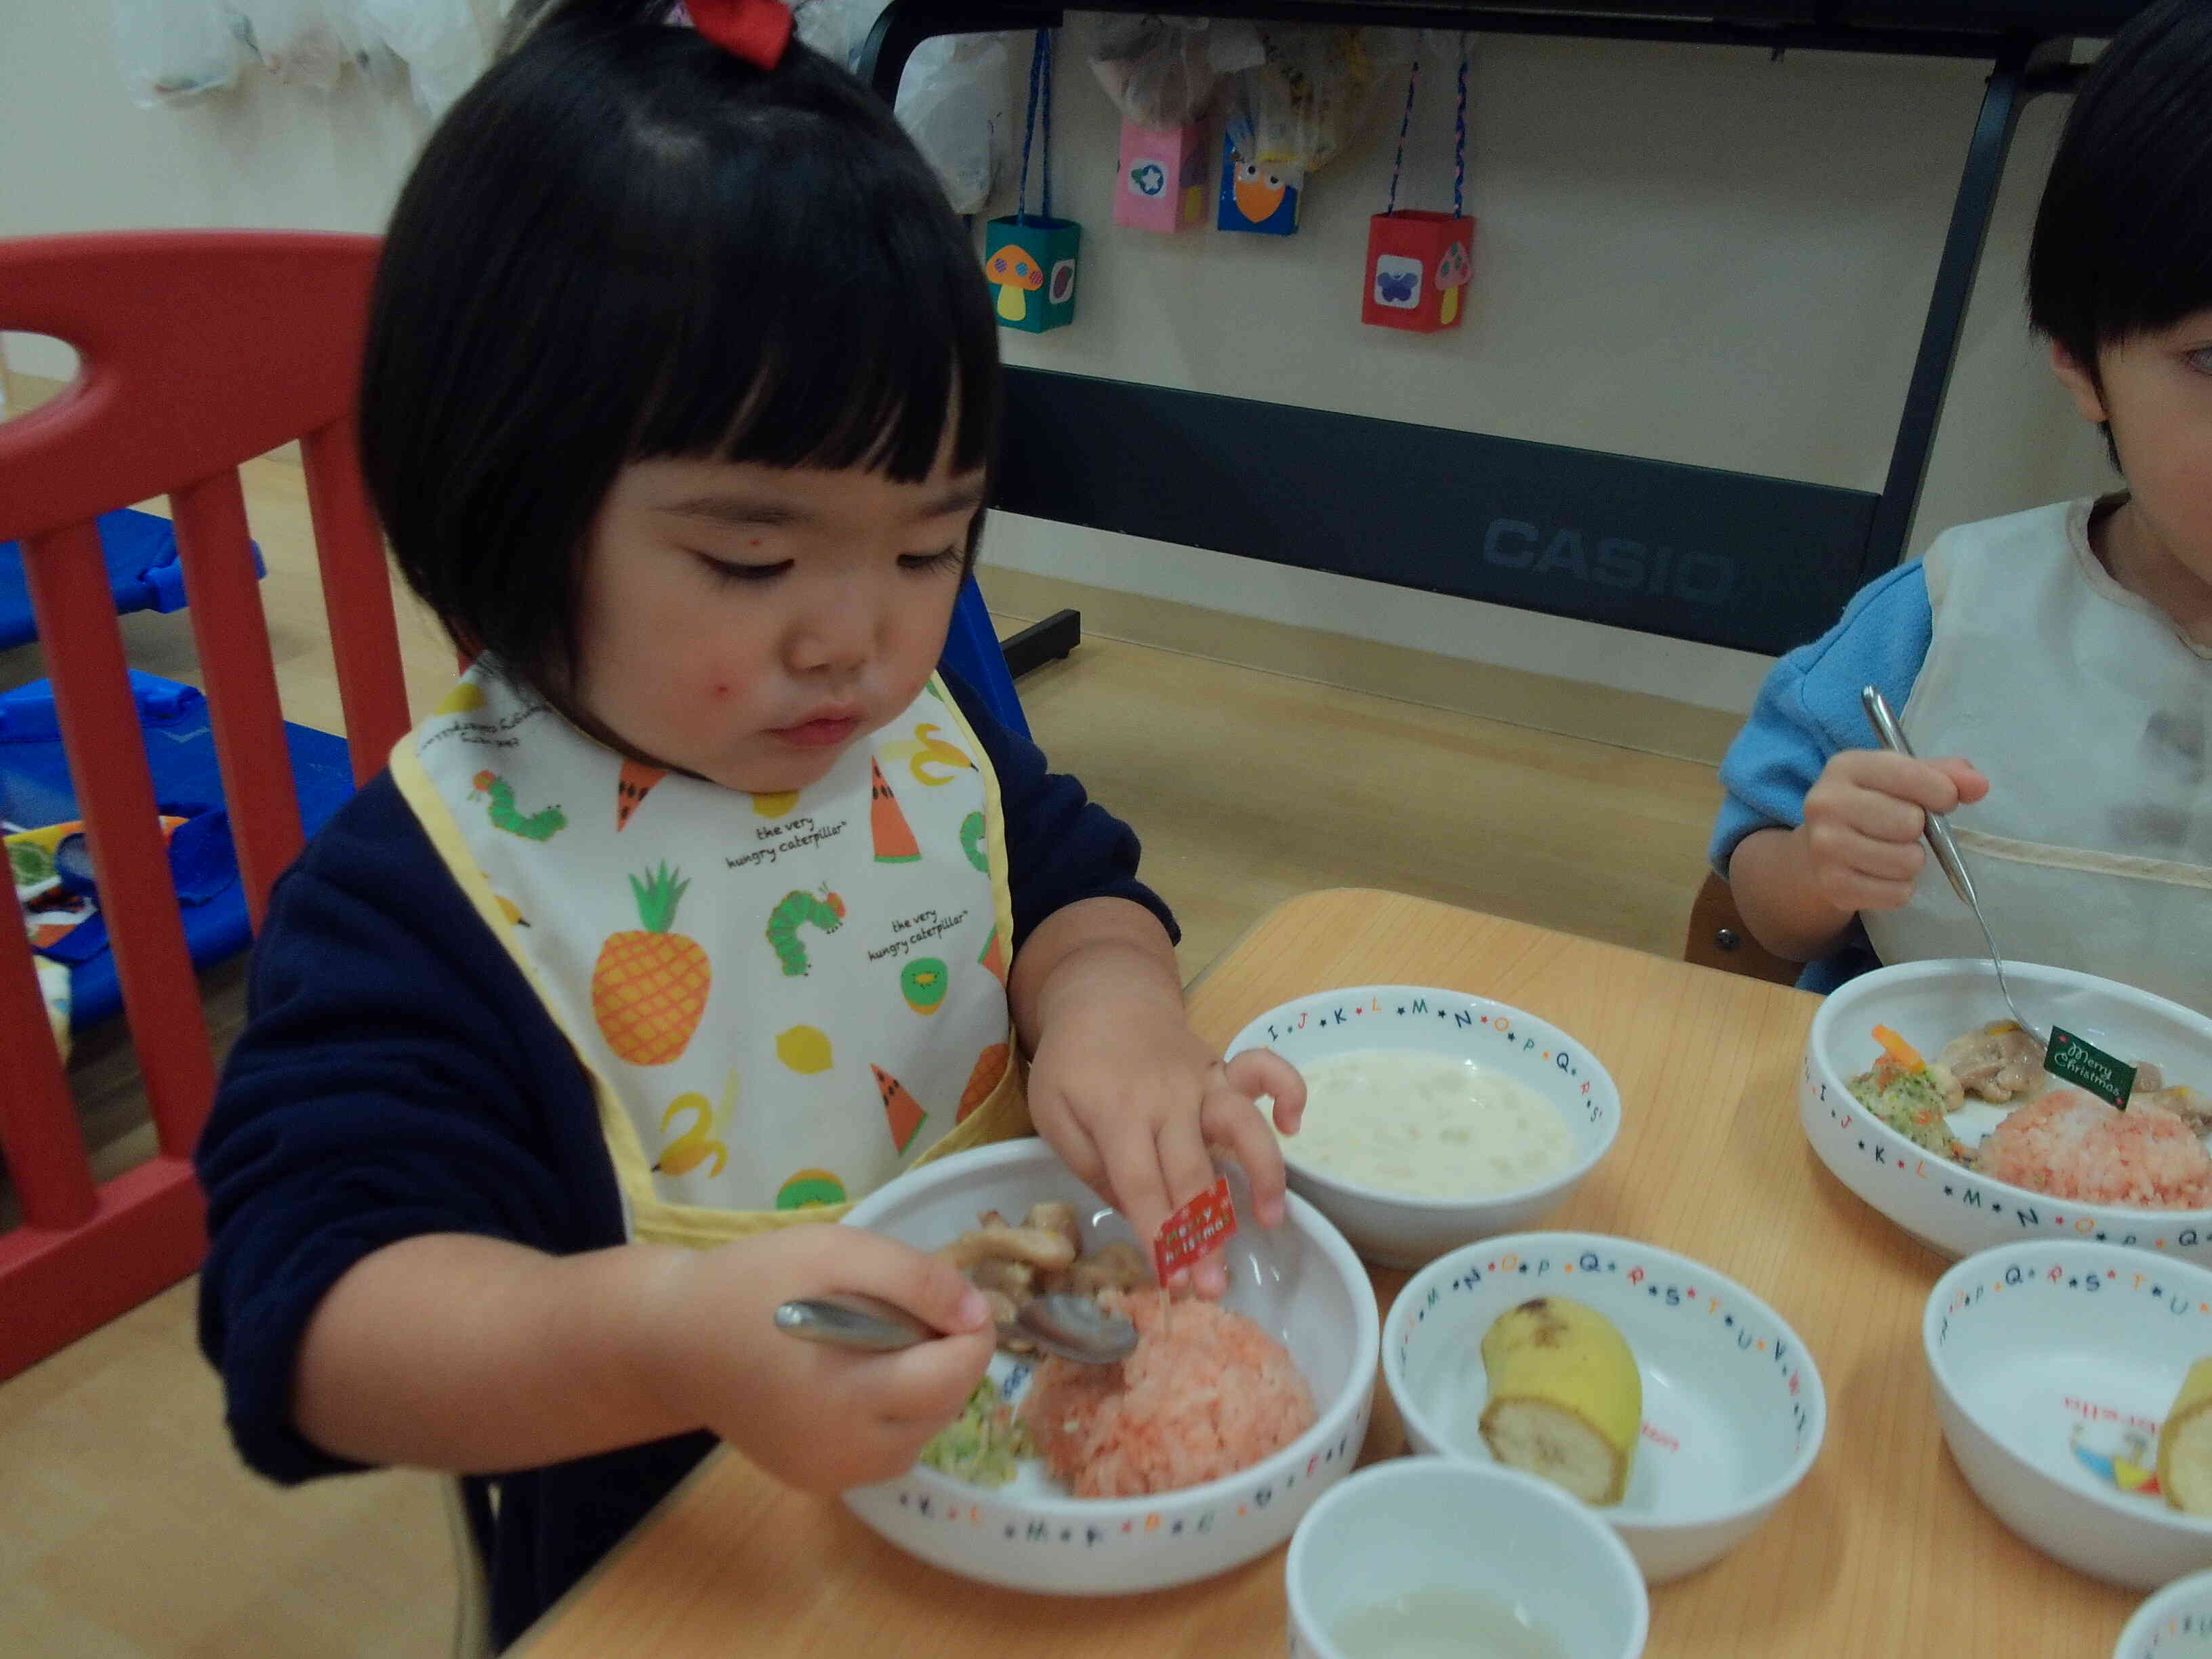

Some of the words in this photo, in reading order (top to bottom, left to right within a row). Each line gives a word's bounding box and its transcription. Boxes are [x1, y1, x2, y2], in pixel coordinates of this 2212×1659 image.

[1483, 518, 1734, 605] CASIO
[756, 825, 783, 840] the
[785, 817, 814, 832] very
[725, 847, 777, 869] hungry
[891, 920, 912, 933] the
[913, 909, 938, 924] very
[867, 939, 909, 963] hungry
[2068, 1042, 2113, 1081] Merry
[2054, 1052, 2121, 1097] Christmas
